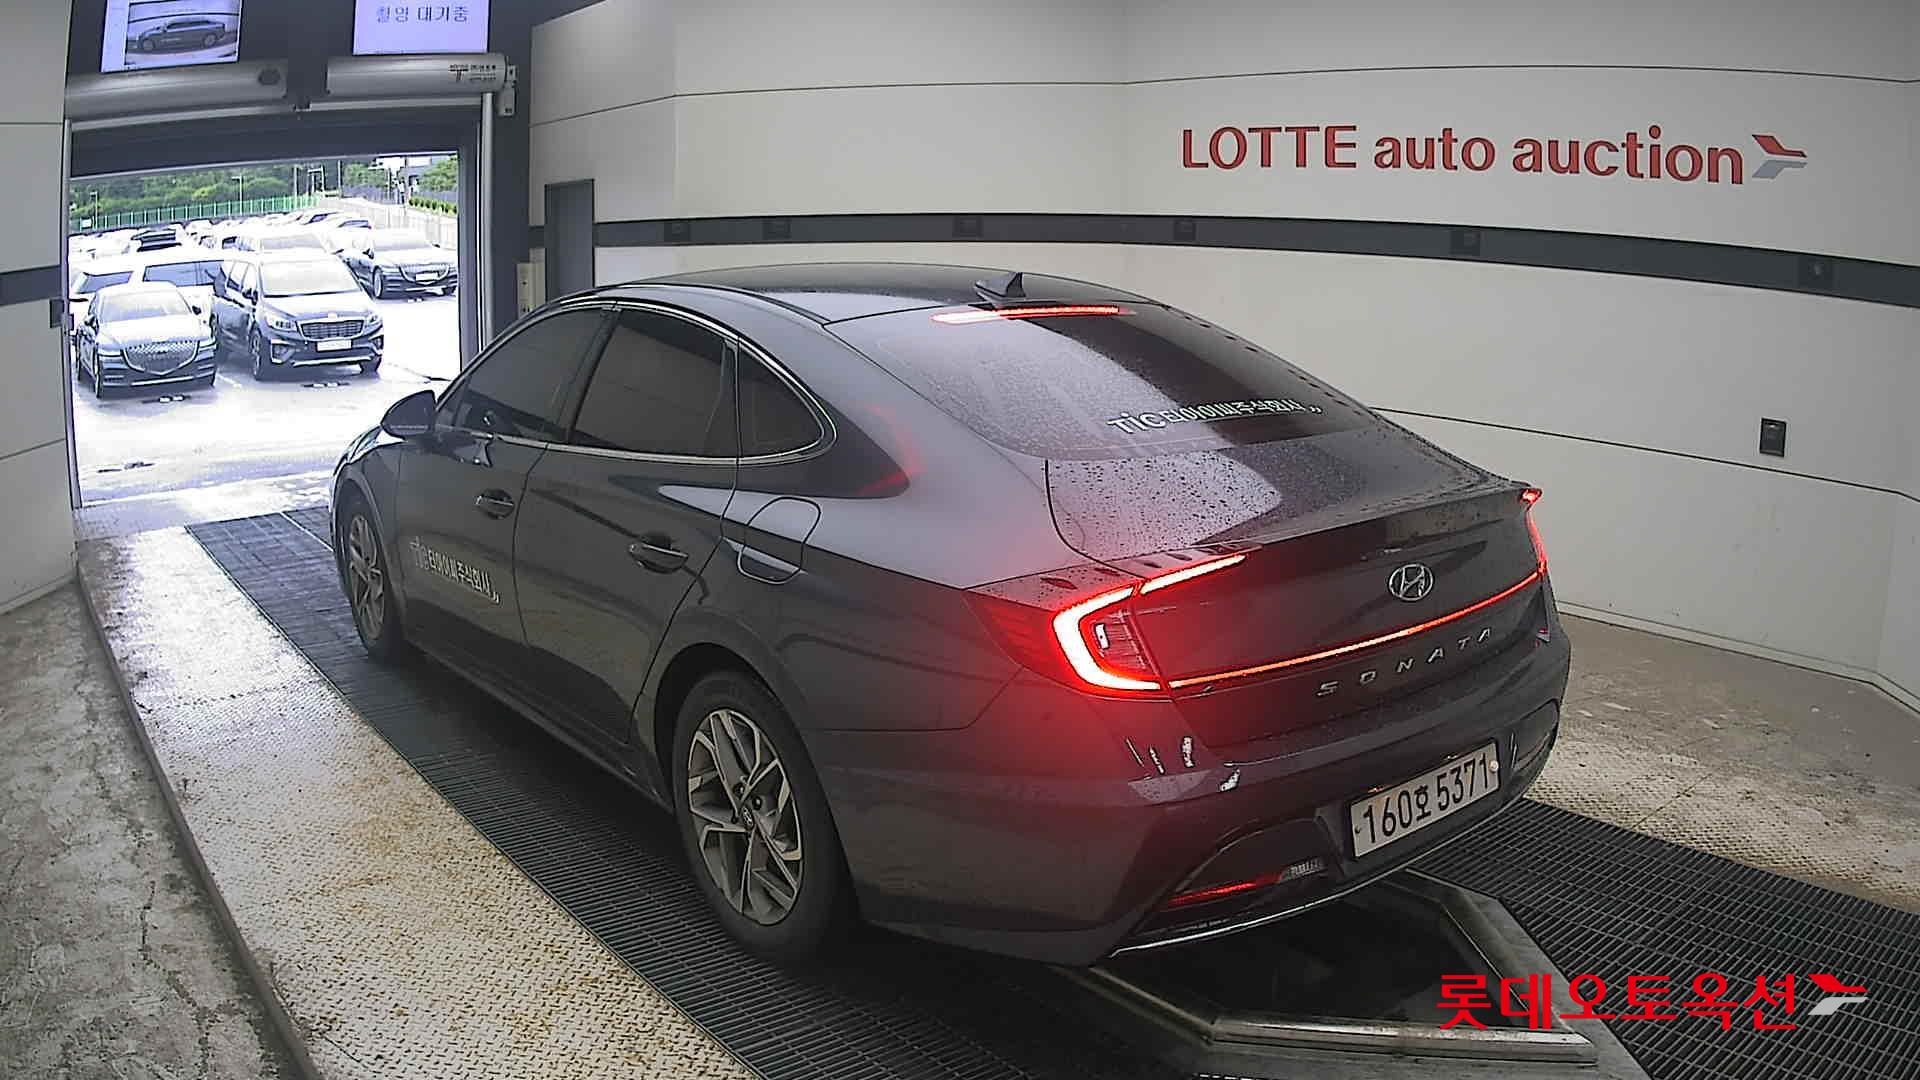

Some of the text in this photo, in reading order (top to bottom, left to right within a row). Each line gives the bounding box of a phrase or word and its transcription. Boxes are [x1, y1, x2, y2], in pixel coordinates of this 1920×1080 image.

[417, 5, 469, 22] 대기중
[1182, 124, 1744, 185] LOTTE auto auction
[1317, 628, 1491, 696] SONATA
[1363, 753, 1488, 843] 160호 5371
